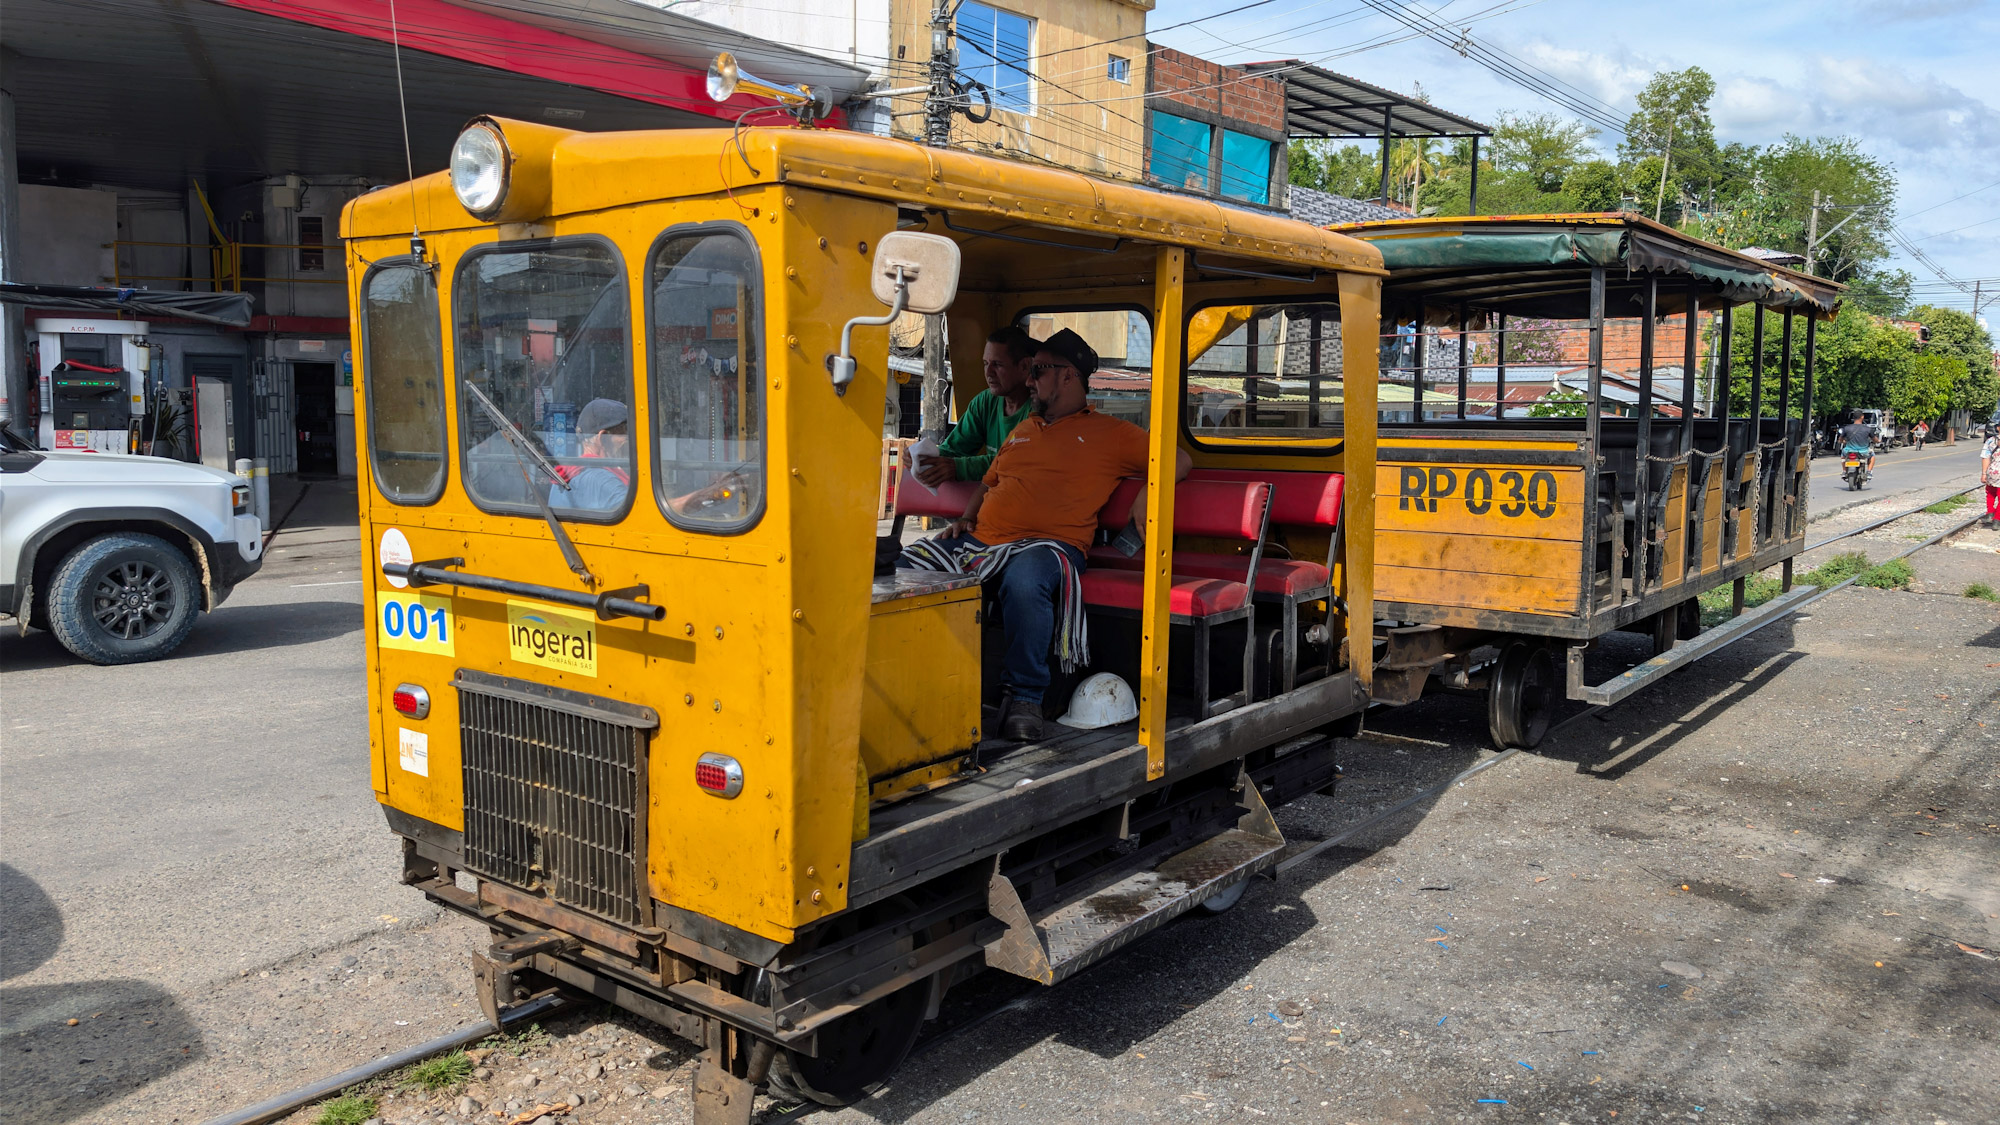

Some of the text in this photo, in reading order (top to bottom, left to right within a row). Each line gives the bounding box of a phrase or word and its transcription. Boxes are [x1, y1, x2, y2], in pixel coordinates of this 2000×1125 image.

[1464, 468, 1557, 519] 030
[384, 600, 447, 642] 001
[511, 624, 592, 661] ingeral
